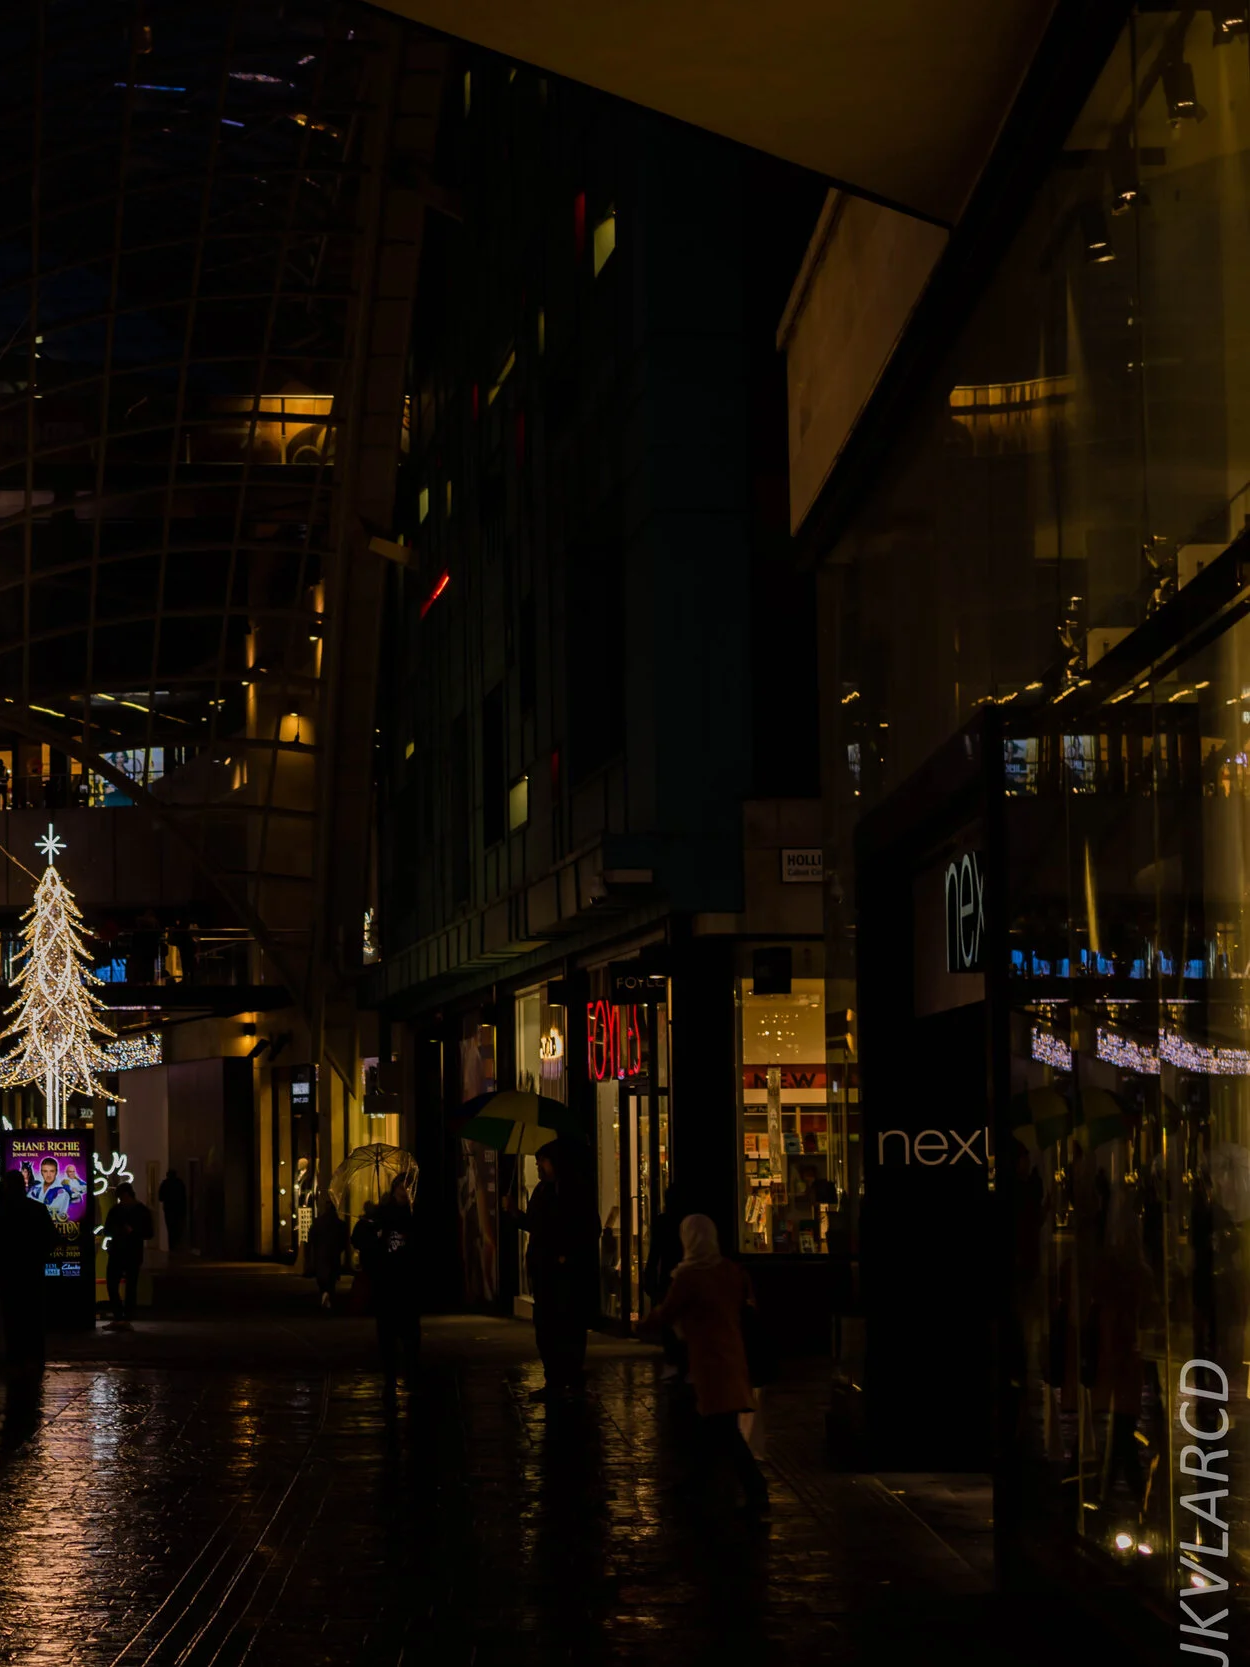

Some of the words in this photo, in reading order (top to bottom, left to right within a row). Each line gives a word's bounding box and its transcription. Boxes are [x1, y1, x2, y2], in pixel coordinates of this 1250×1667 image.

[787, 854, 822, 866] HOLLI
[945, 851, 985, 973] nex
[616, 976, 666, 990] FOYLE
[12, 1141, 45, 1152] SHANE
[47, 1141, 80, 1152] RICHIE
